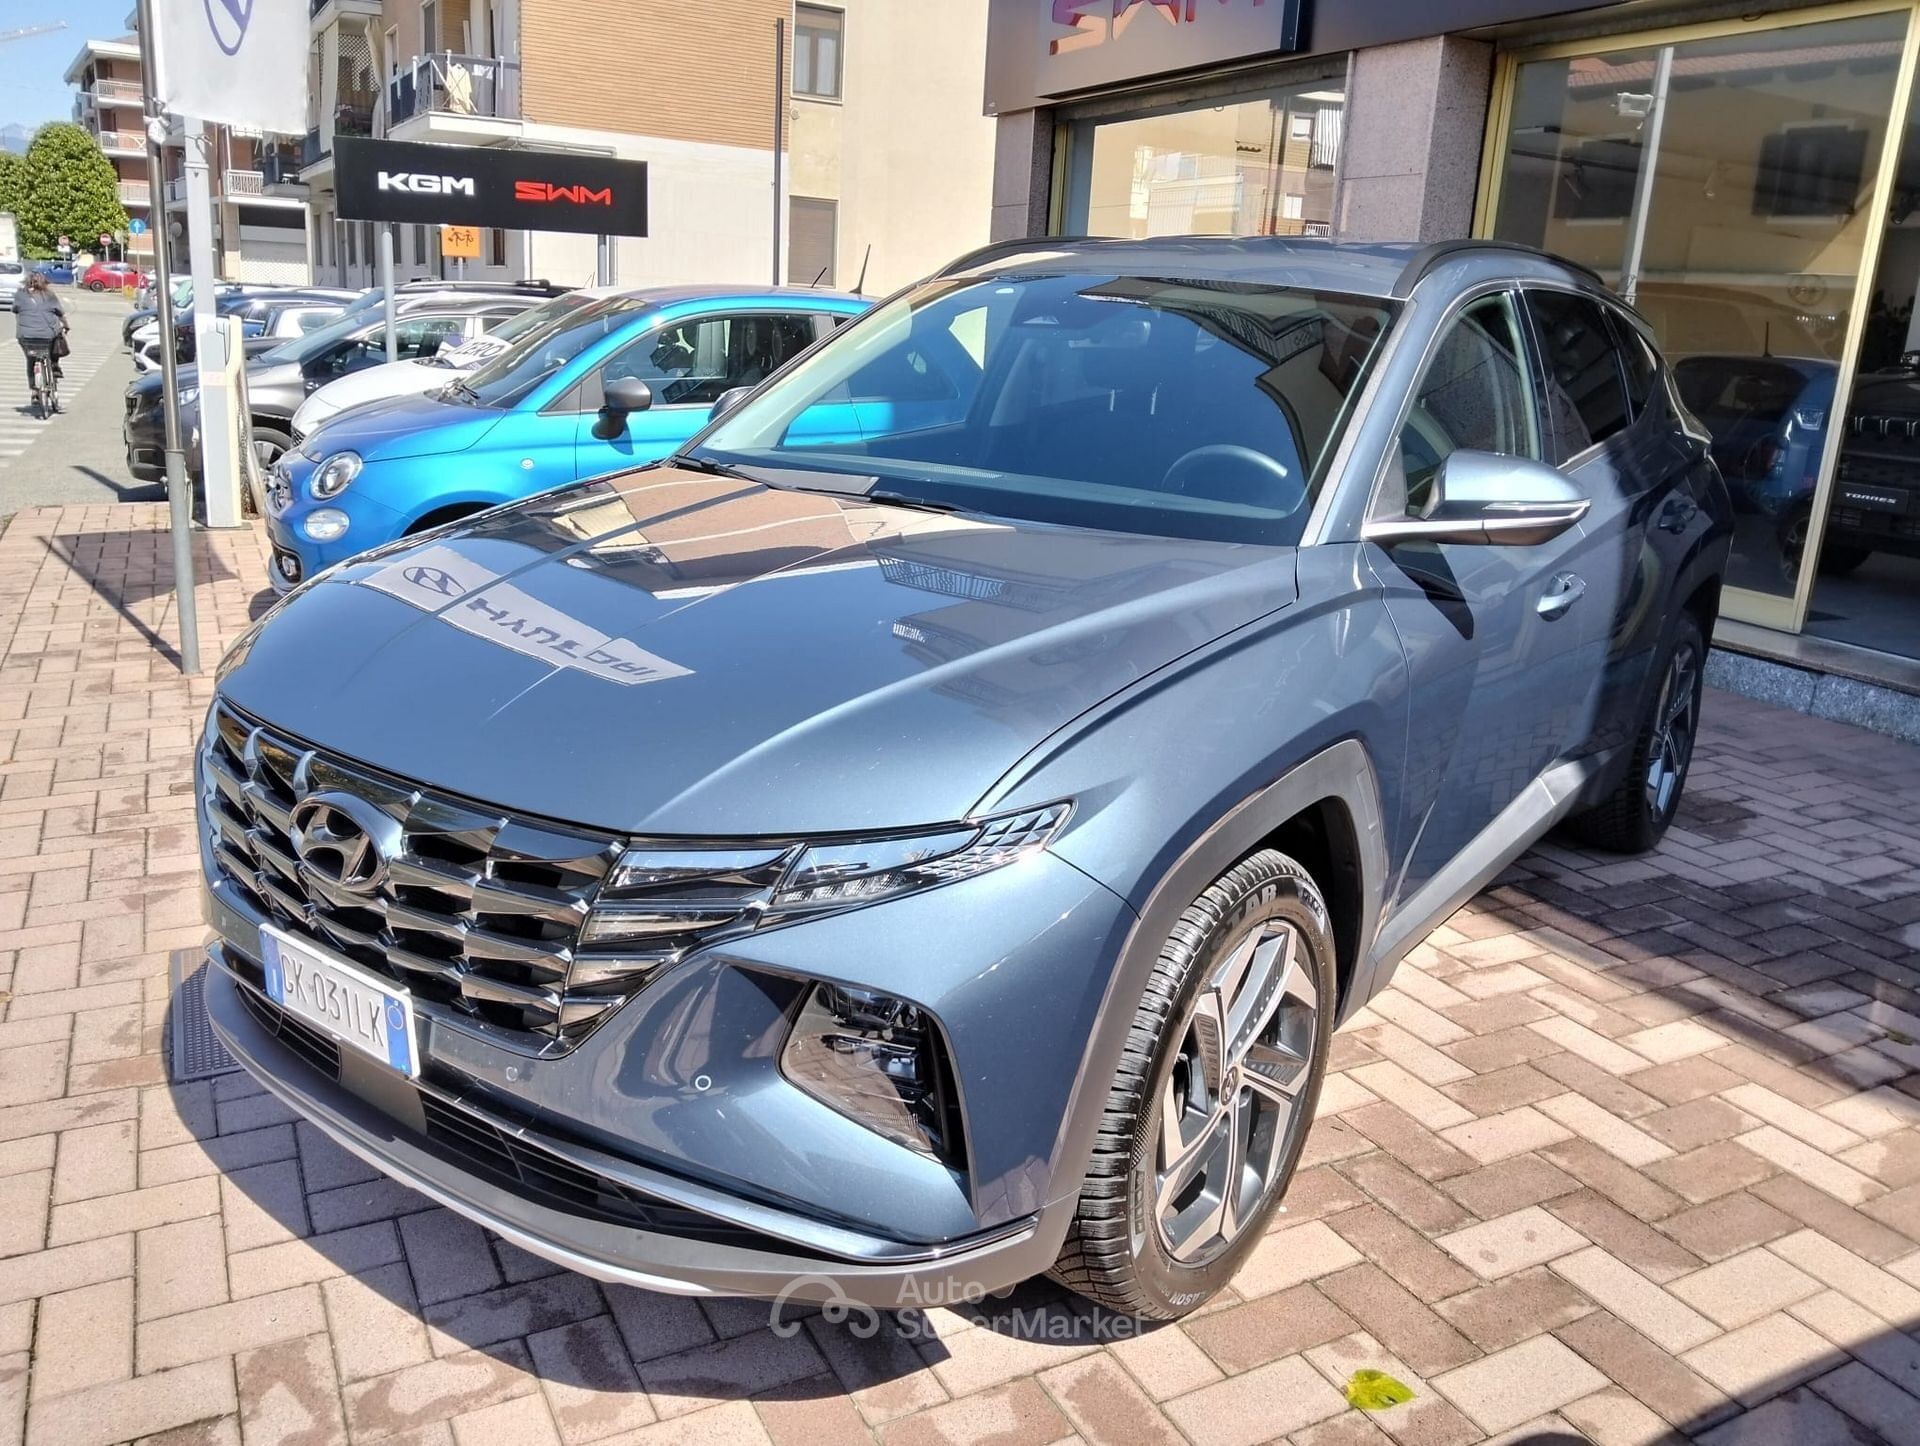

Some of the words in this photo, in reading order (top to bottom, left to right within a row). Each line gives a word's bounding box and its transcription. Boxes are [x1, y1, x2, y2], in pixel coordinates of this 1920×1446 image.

[377, 171, 475, 196] KGM
[514, 181, 611, 205] SWM
[1845, 492, 1896, 504] TORRES
